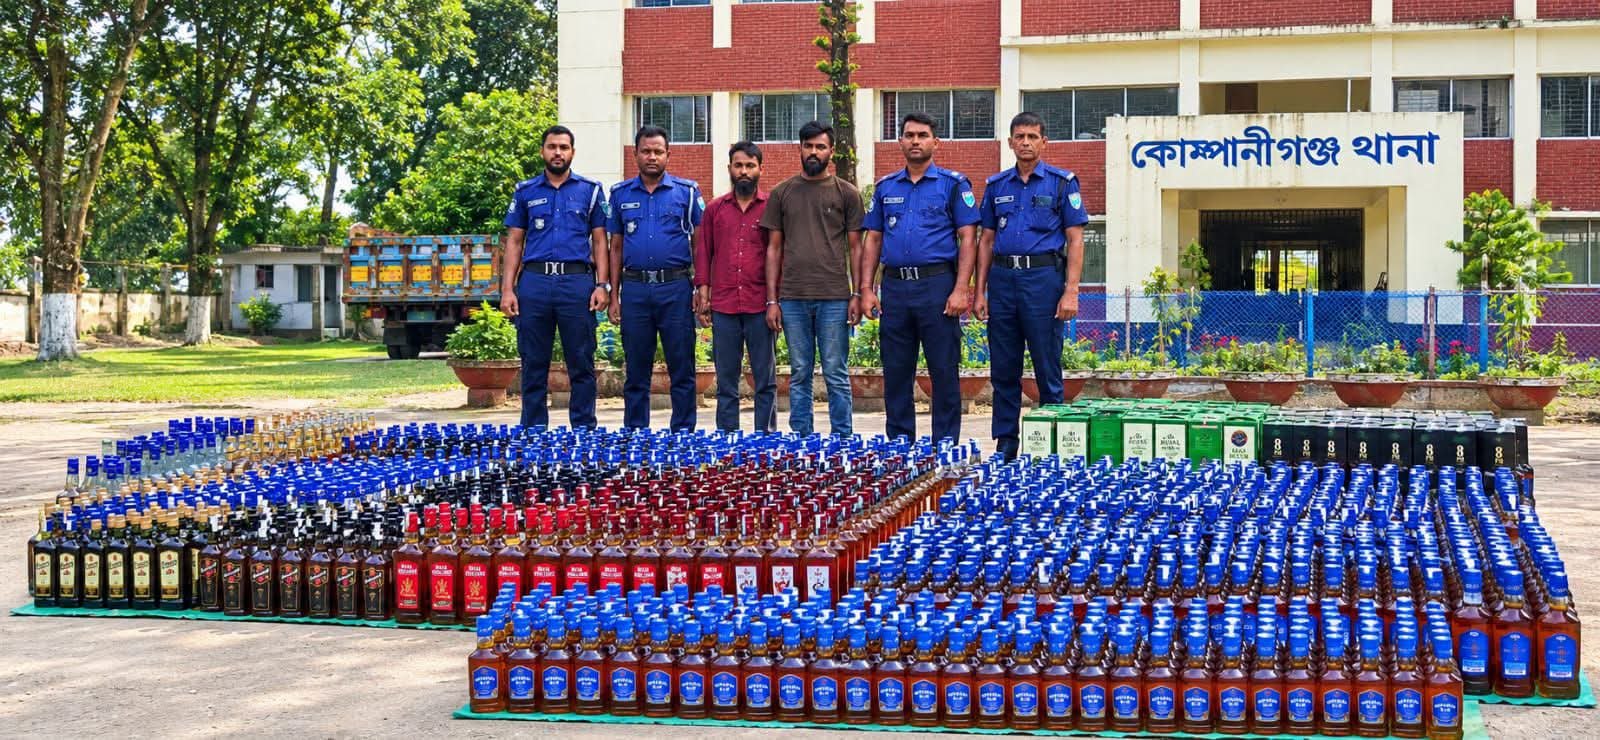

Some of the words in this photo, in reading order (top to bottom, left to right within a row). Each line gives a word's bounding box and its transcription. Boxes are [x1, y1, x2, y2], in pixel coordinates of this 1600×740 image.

[1353, 131, 1440, 166] থানা
[1274, 438, 1282, 449] 8
[1303, 440, 1310, 450] 8
[1328, 440, 1335, 452] 8
[1359, 441, 1367, 453] 8
[1392, 442, 1400, 454] 8
[1426, 444, 1434, 455] 8
[1456, 445, 1464, 457] 8
[1495, 446, 1503, 458] 8
